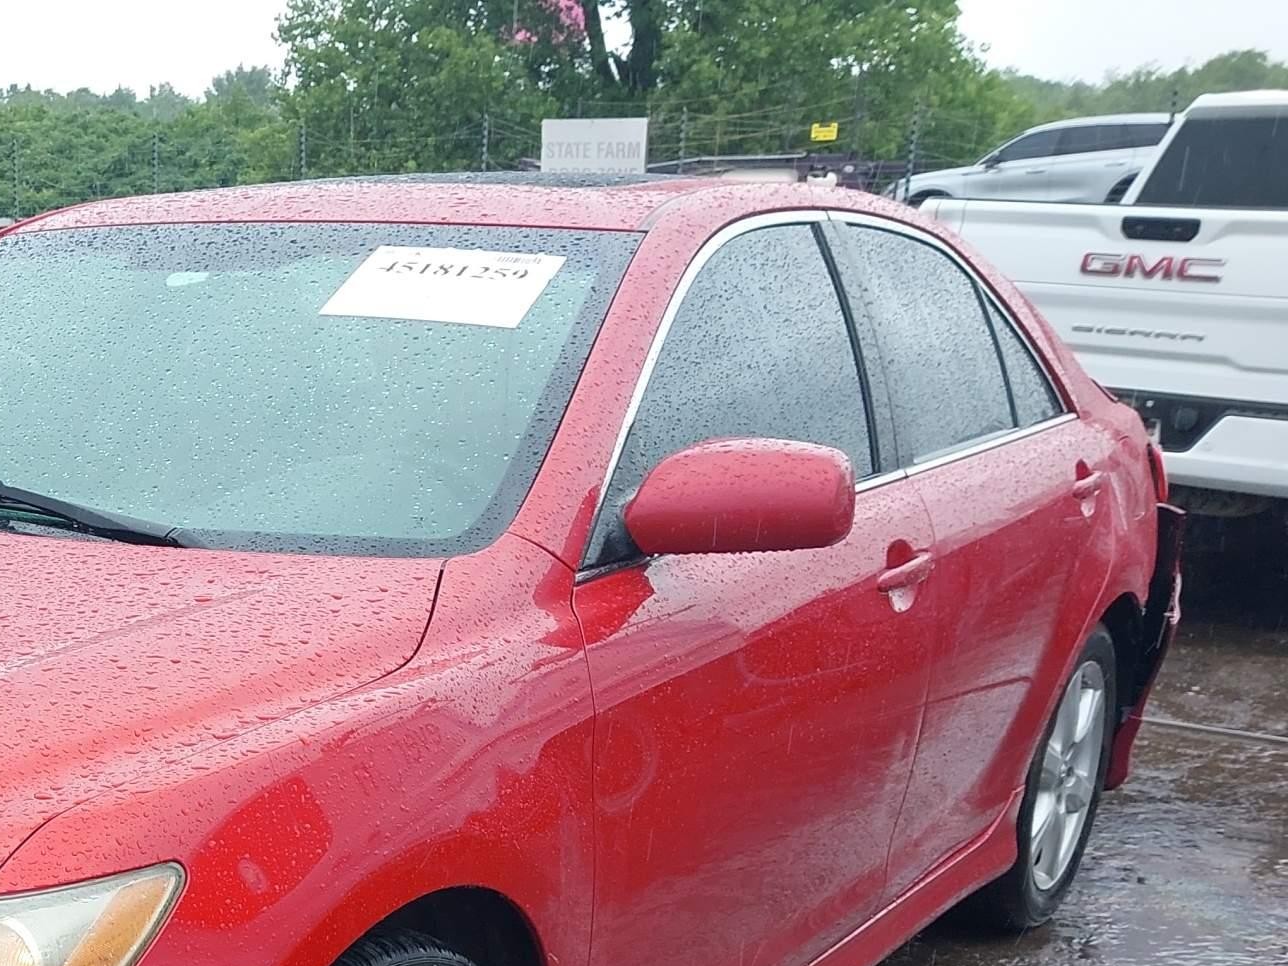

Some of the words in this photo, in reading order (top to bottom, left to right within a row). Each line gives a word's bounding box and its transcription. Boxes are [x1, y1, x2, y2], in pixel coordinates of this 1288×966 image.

[546, 141, 591, 159] STATE
[597, 141, 641, 159] FARM
[377, 261, 529, 280] 45181259
[1080, 252, 1228, 283] GMC
